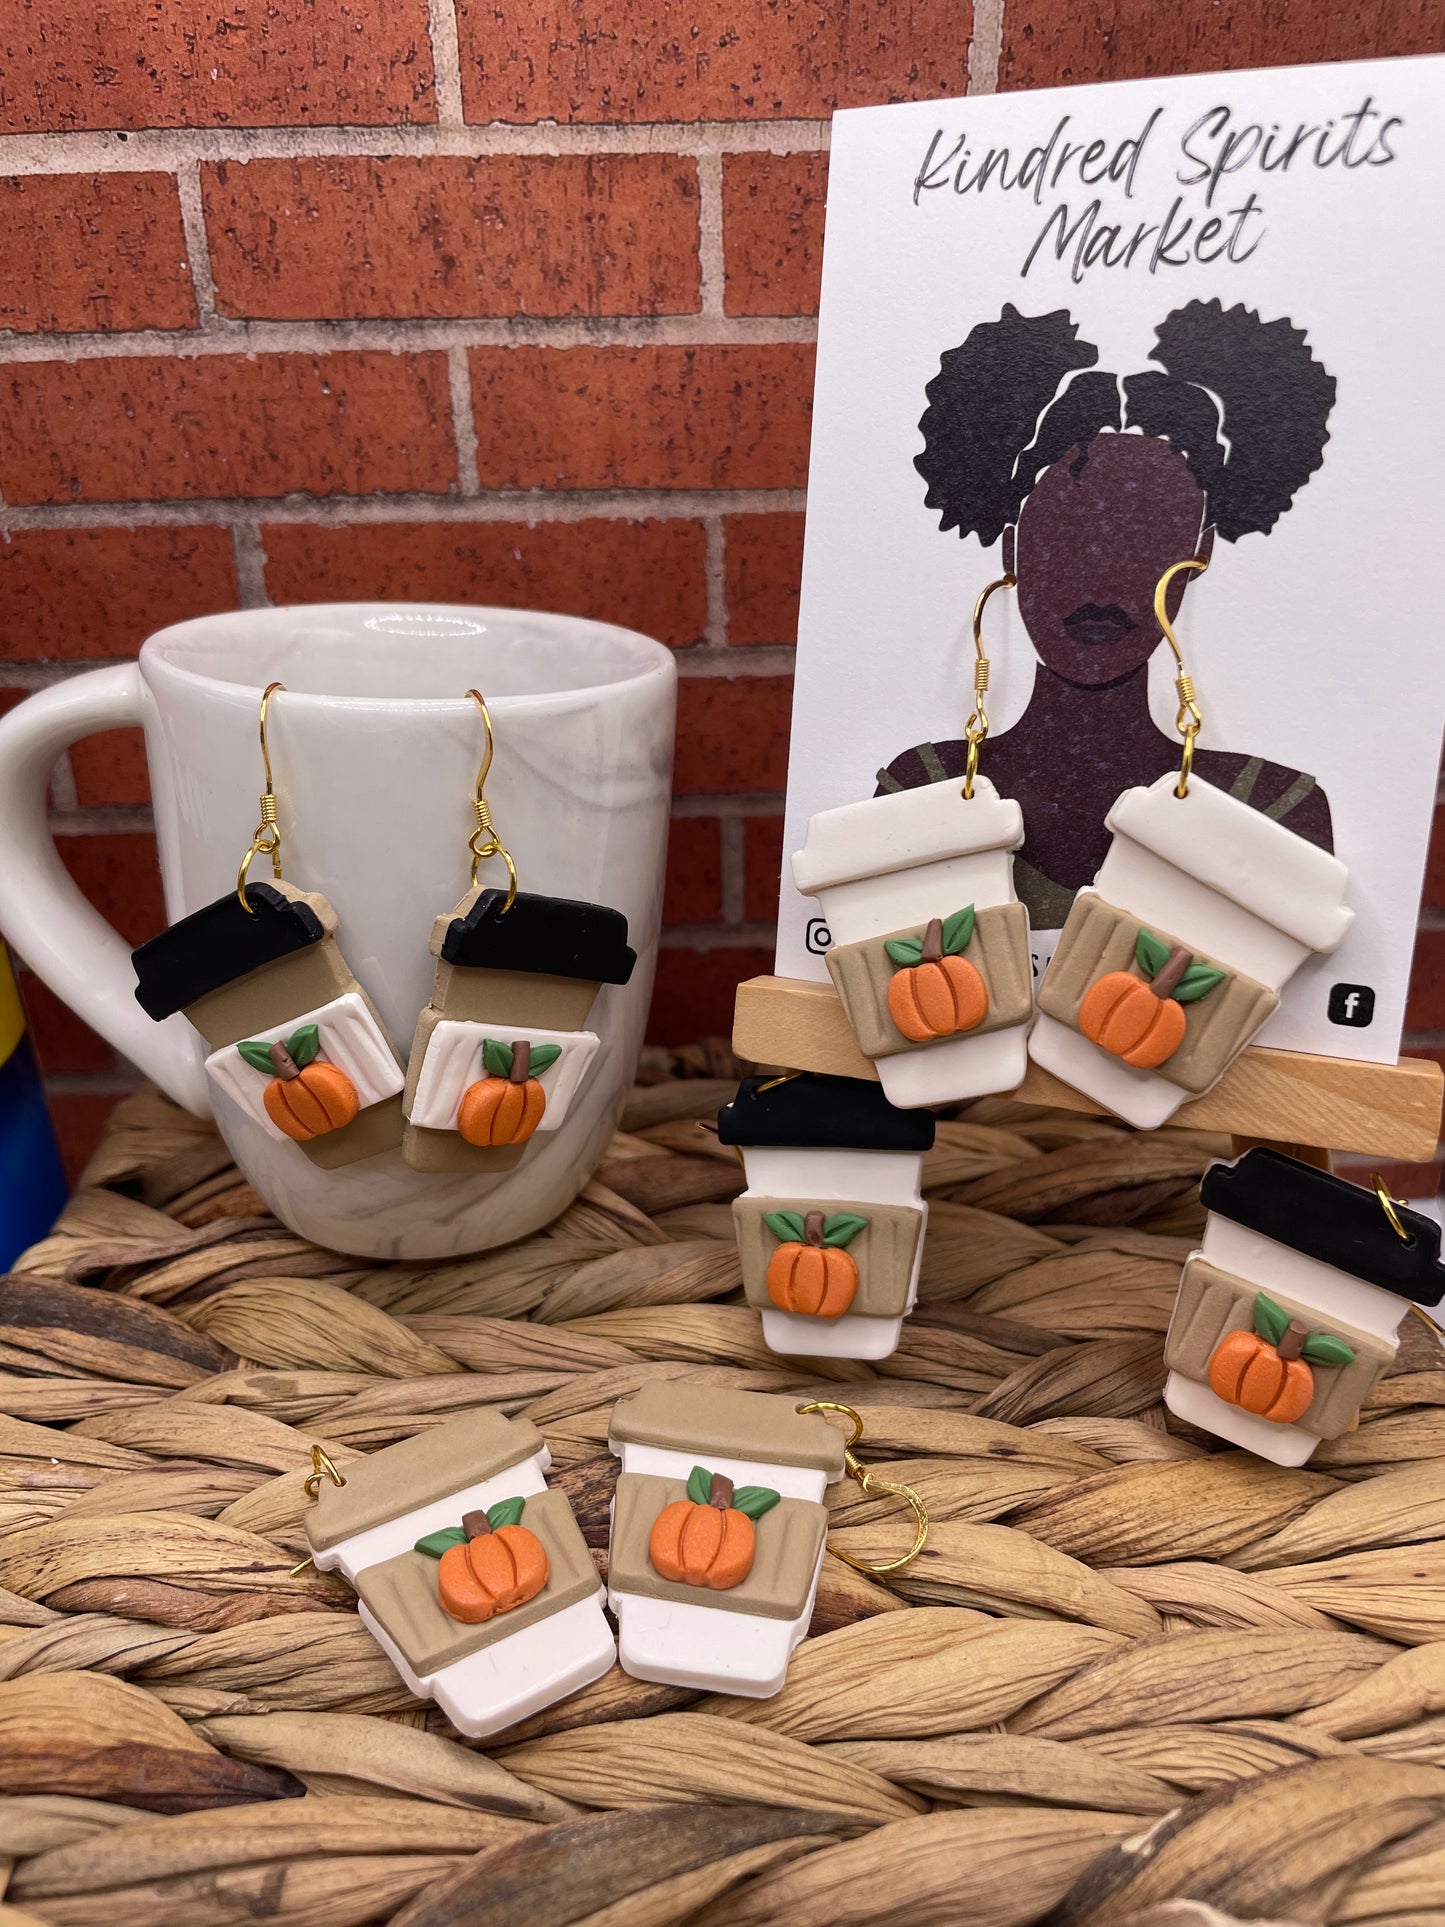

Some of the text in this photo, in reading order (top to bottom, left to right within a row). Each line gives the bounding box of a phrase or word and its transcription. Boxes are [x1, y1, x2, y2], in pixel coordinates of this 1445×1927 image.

[913, 97, 1404, 208] Kindred Spirits
[1020, 193, 1267, 284] Market
